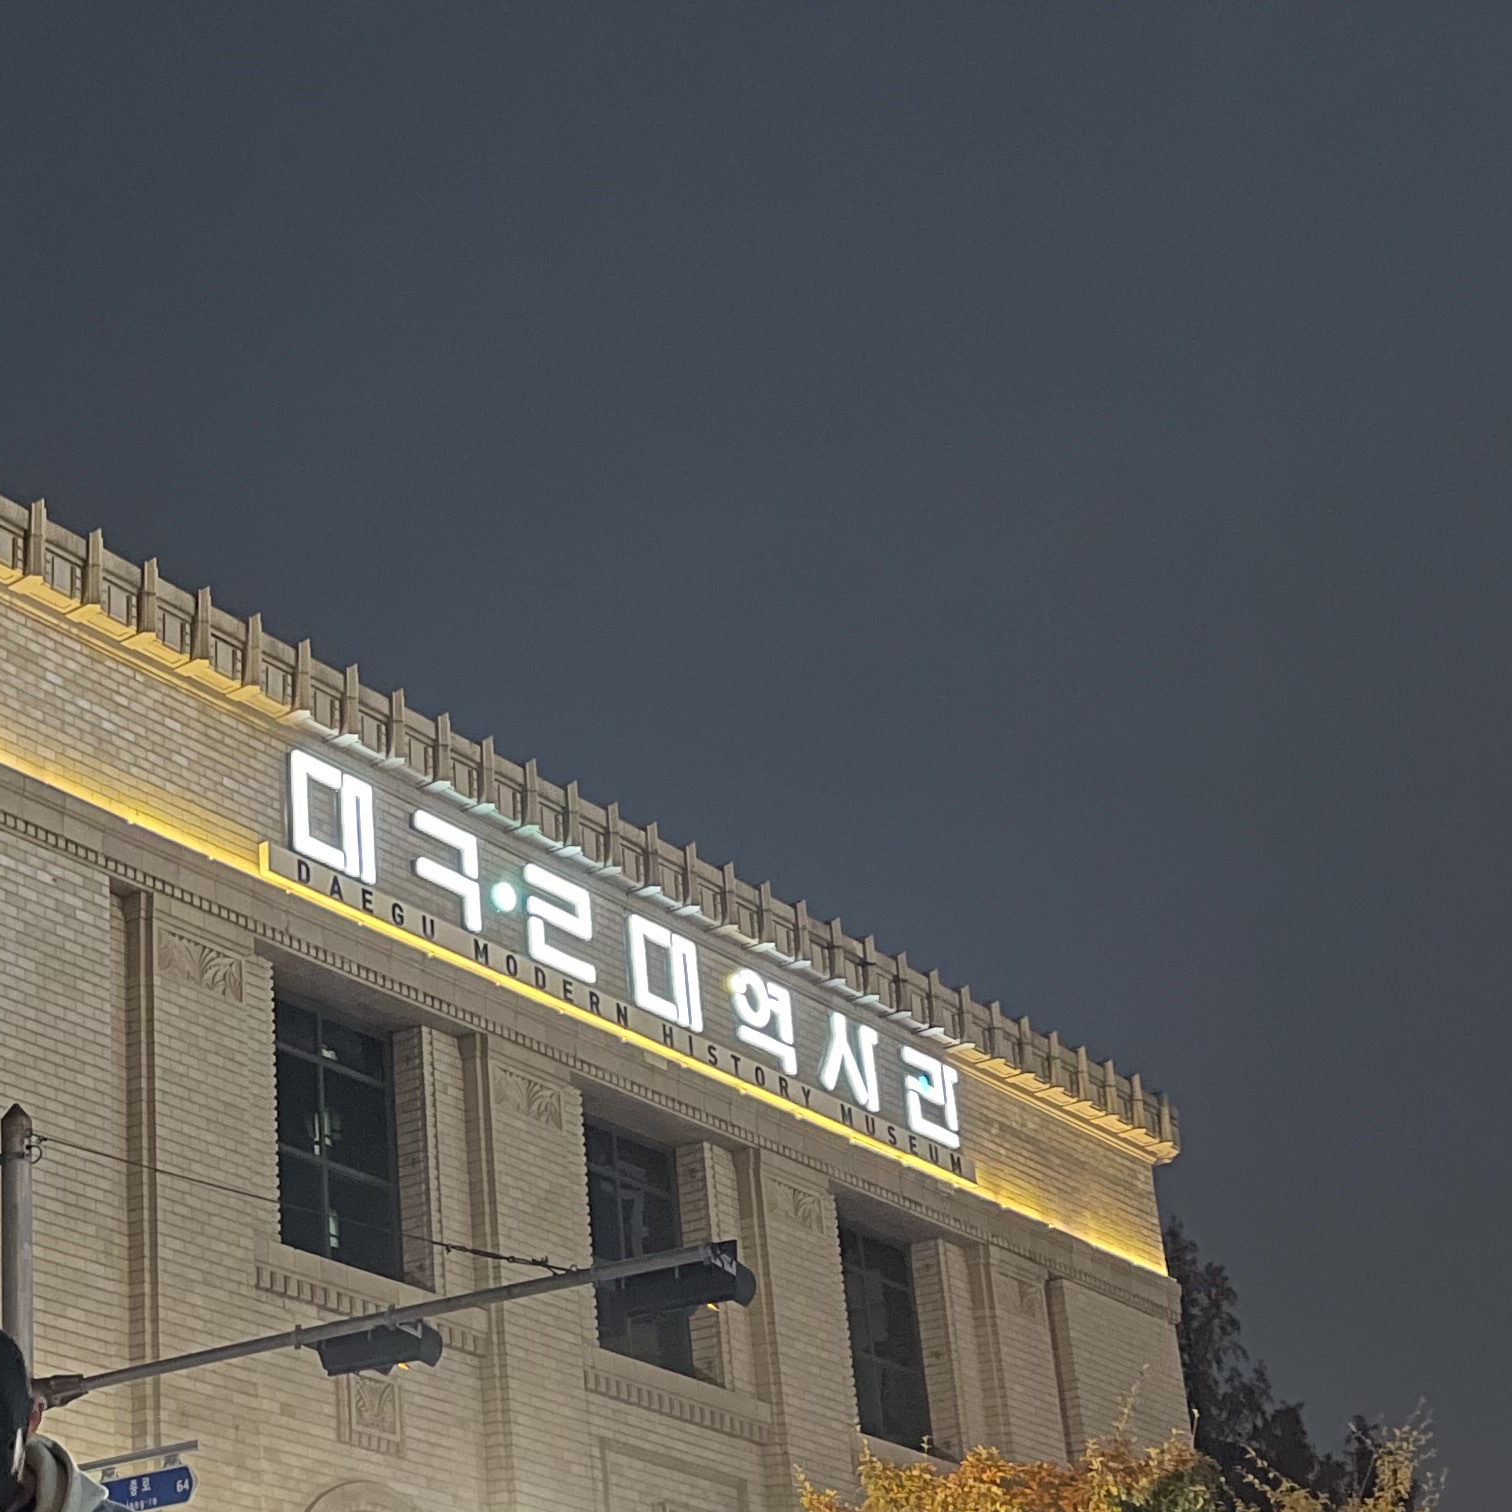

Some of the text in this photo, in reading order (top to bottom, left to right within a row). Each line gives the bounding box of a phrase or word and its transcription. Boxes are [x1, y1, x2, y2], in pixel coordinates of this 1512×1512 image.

[296, 858, 964, 1175] DAEGU MODERN HISTORY MUSEUM
[176, 1478, 190, 1493] 64
